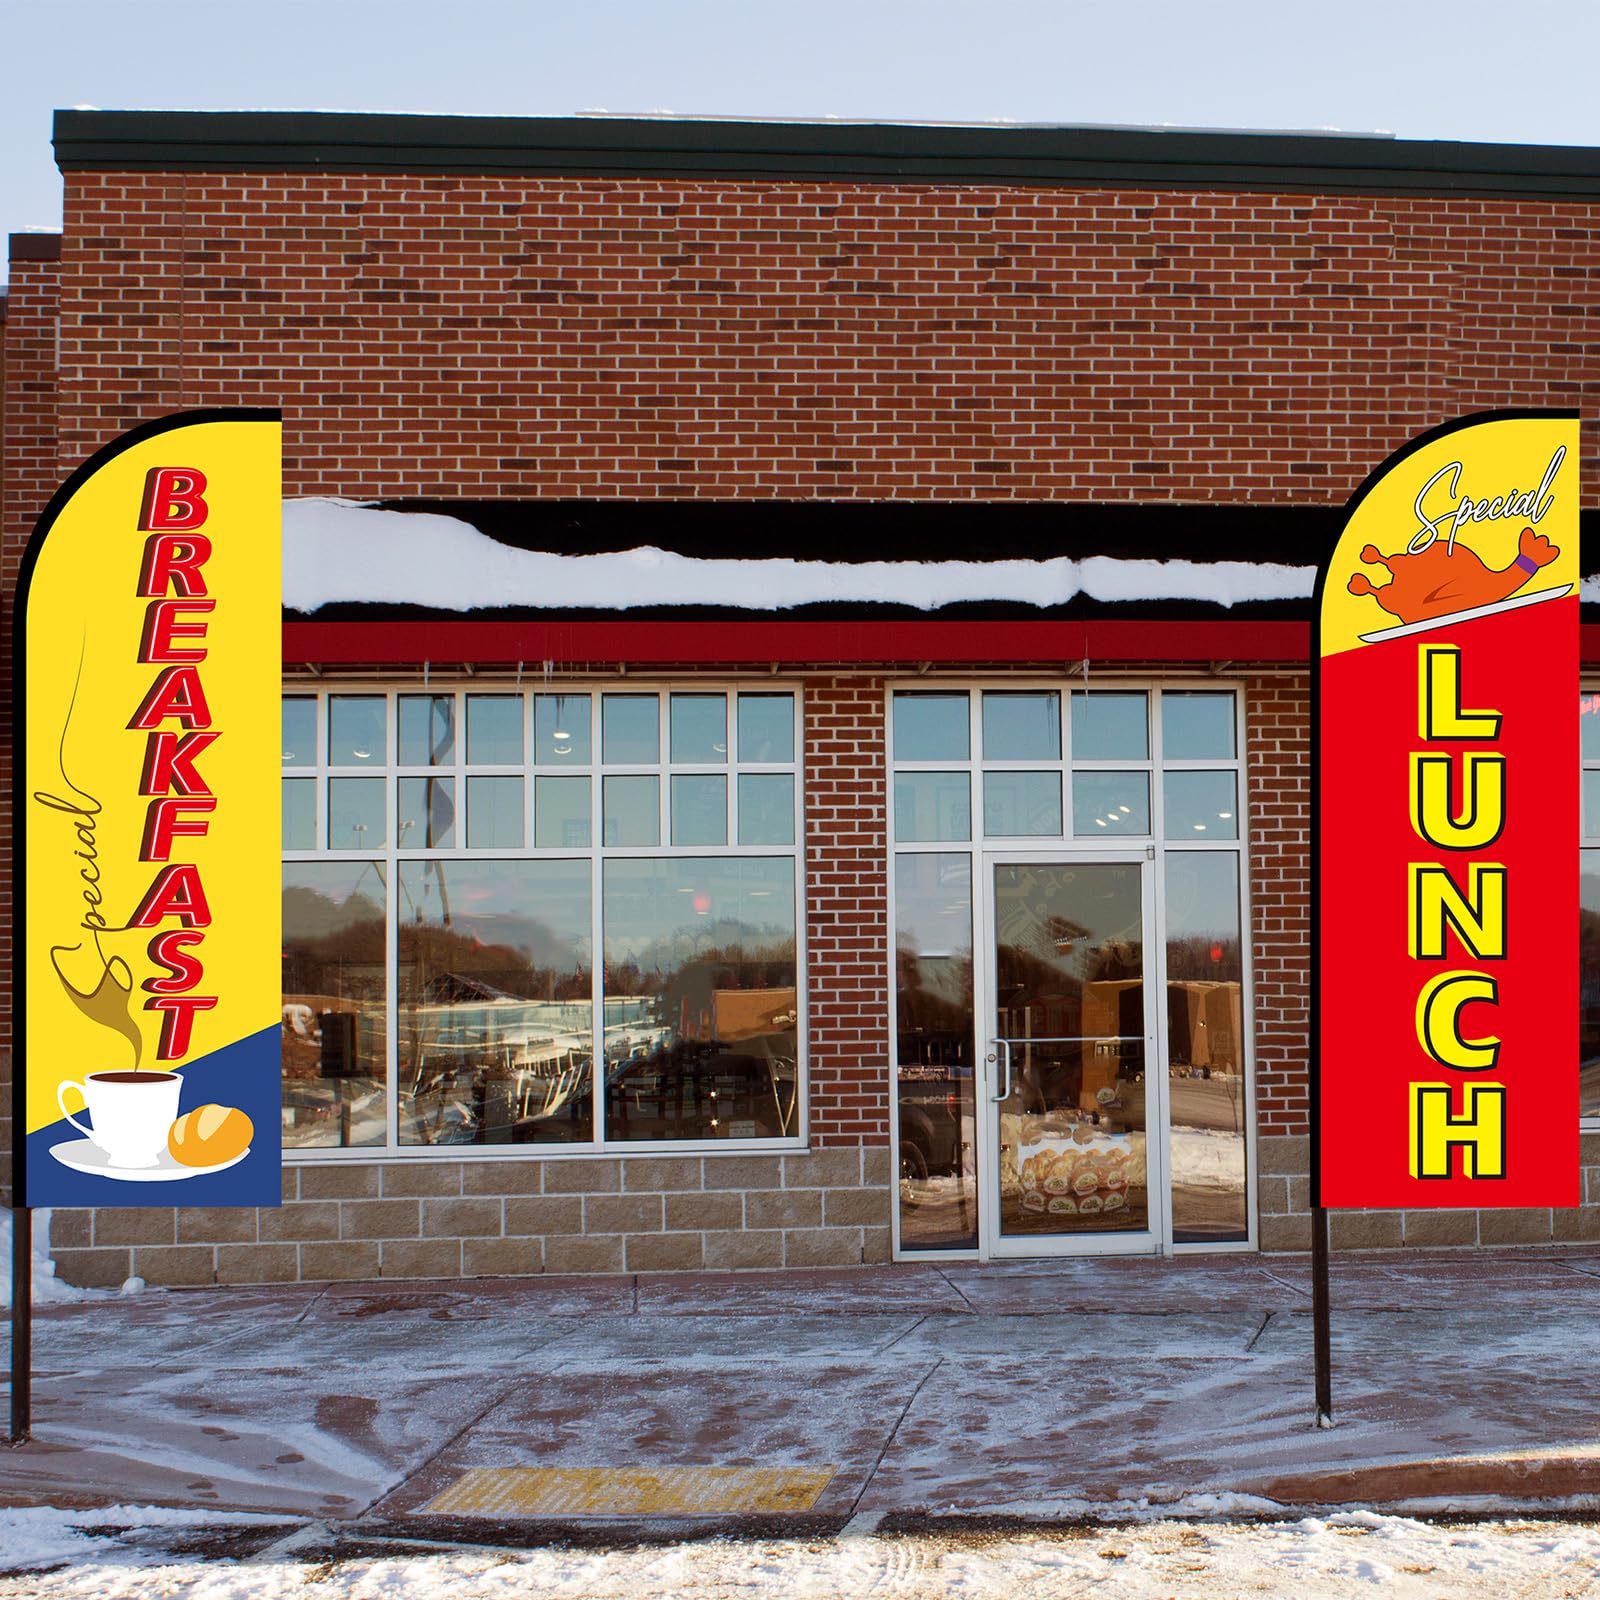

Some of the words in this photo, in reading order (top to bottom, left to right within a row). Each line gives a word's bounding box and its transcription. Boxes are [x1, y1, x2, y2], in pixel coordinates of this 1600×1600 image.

[1407, 445, 1566, 557] Special
[33, 736, 133, 1002] Special
[125, 466, 223, 1060] BREAKFAST
[1408, 643, 1507, 1180] LUNCH
